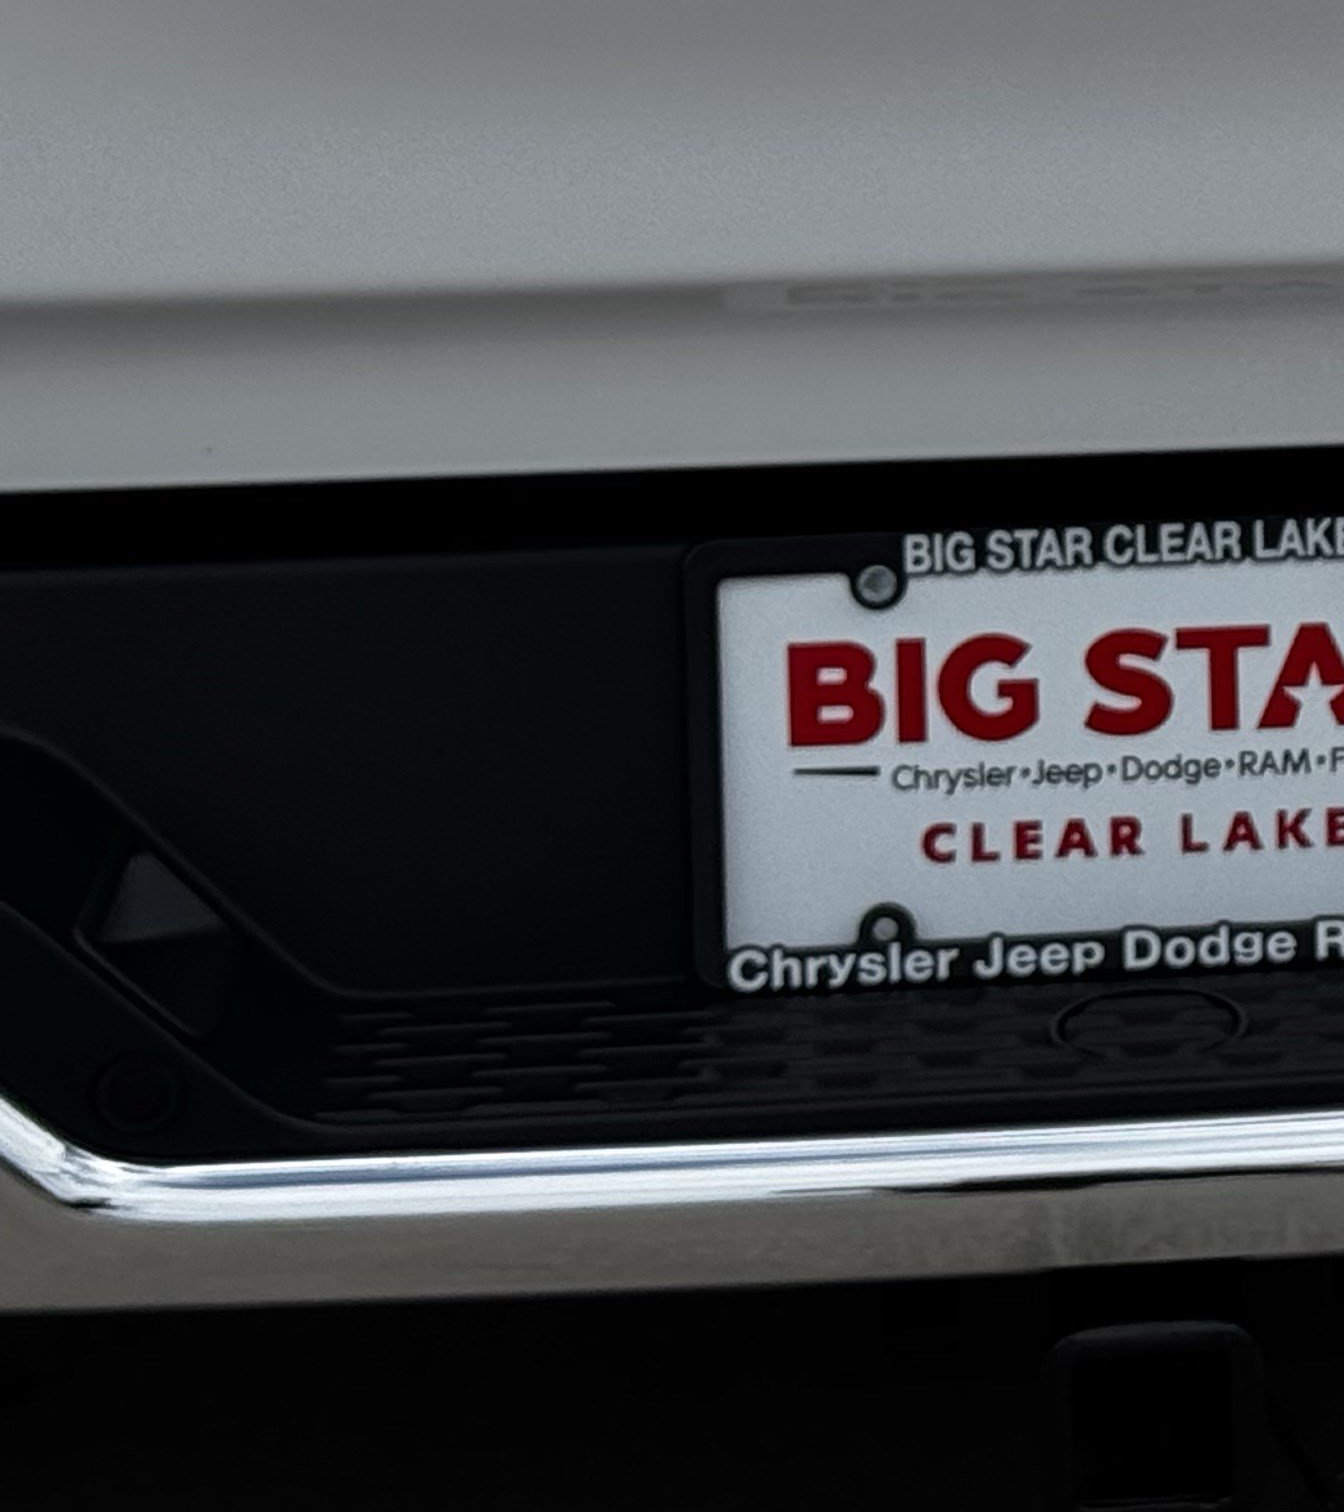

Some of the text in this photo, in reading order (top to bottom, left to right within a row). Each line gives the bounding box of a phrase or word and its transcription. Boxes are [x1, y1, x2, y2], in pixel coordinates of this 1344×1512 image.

[903, 532, 976, 574] BIG
[986, 526, 1094, 570] STAR
[1104, 520, 1242, 564] CLEAR
[787, 634, 1038, 746] BIG
[920, 816, 1145, 863] CLEAR
[727, 946, 958, 993] Chrysler
[974, 935, 1104, 979] Jeep
[1122, 925, 1297, 969] Dodge
